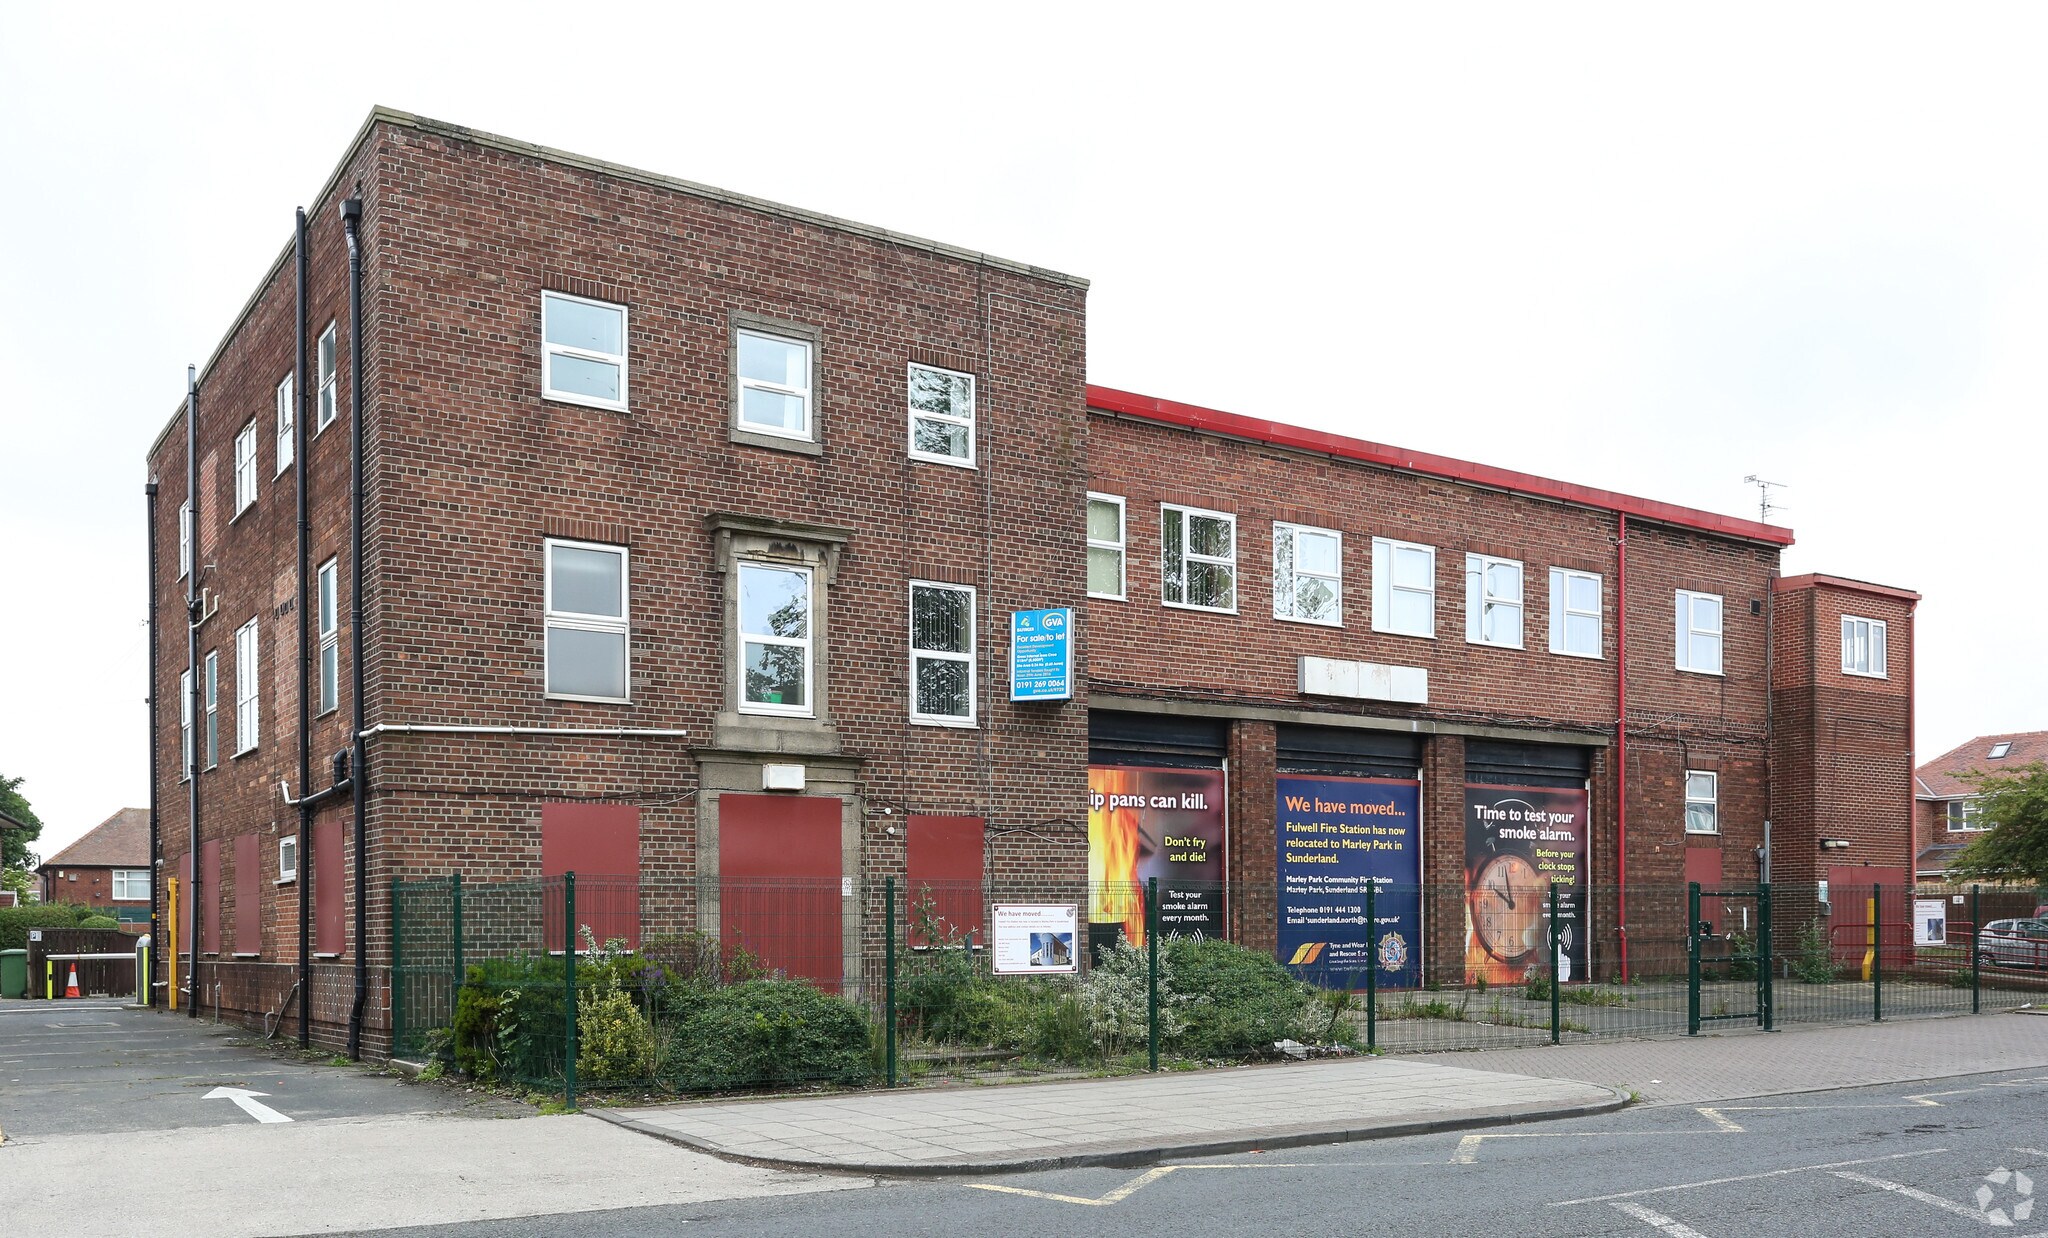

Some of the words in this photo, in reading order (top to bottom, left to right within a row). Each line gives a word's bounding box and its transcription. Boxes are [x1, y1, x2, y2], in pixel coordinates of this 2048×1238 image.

[1045, 618, 1064, 626] GVA
[1088, 789, 1104, 810] ip
[1110, 794, 1146, 810] pans
[1150, 795, 1176, 809] can
[1182, 793, 1208, 810] kill.
[1285, 796, 1310, 812] We
[1315, 798, 1346, 813] have
[1350, 801, 1406, 816] moved...
[1474, 804, 1506, 820] Time
[1509, 808, 1521, 821] to
[1524, 809, 1546, 822] test
[1549, 812, 1574, 826] your
[1286, 822, 1318, 833] Fulwell
[1320, 823, 1337, 833] Fire
[1340, 824, 1371, 835] Station
[1373, 825, 1386, 835] has
[1388, 827, 1406, 836] now
[1499, 826, 1536, 840] smoke
[1539, 828, 1575, 841] alarm.
[1165, 836, 1190, 846] Don't
[1193, 836, 1206, 849] fry
[1286, 838, 1328, 848] relocated
[1331, 840, 1339, 848] to
[1342, 839, 1371, 852] Marley
[1373, 840, 1392, 850] Park
[1395, 841, 1402, 850] in
[1170, 852, 1186, 862] and
[1189, 852, 1206, 862] die!
[1286, 852, 1339, 863] Sunderland.
[1536, 849, 1558, 857] Before
[1560, 851, 1574, 860] your
[1498, 866, 1504, 877] 11
[1538, 862, 1556, 870] clock
[1557, 863, 1575, 873] stops
[1286, 876, 1307, 884] Marley
[1324, 876, 1359, 885] Community
[1551, 875, 1575, 885] ticking!
[1169, 890, 1184, 898] Test
[1286, 886, 1307, 894] Marley
[1309, 886, 1324, 894] Park,
[1483, 899, 1488, 909] 9
[1287, 906, 1318, 915] Telephone
[1162, 915, 1182, 923] every
[1486, 917, 1492, 928] 8
[1497, 931, 1502, 941] 7
[1508, 936, 1514, 946] 6
